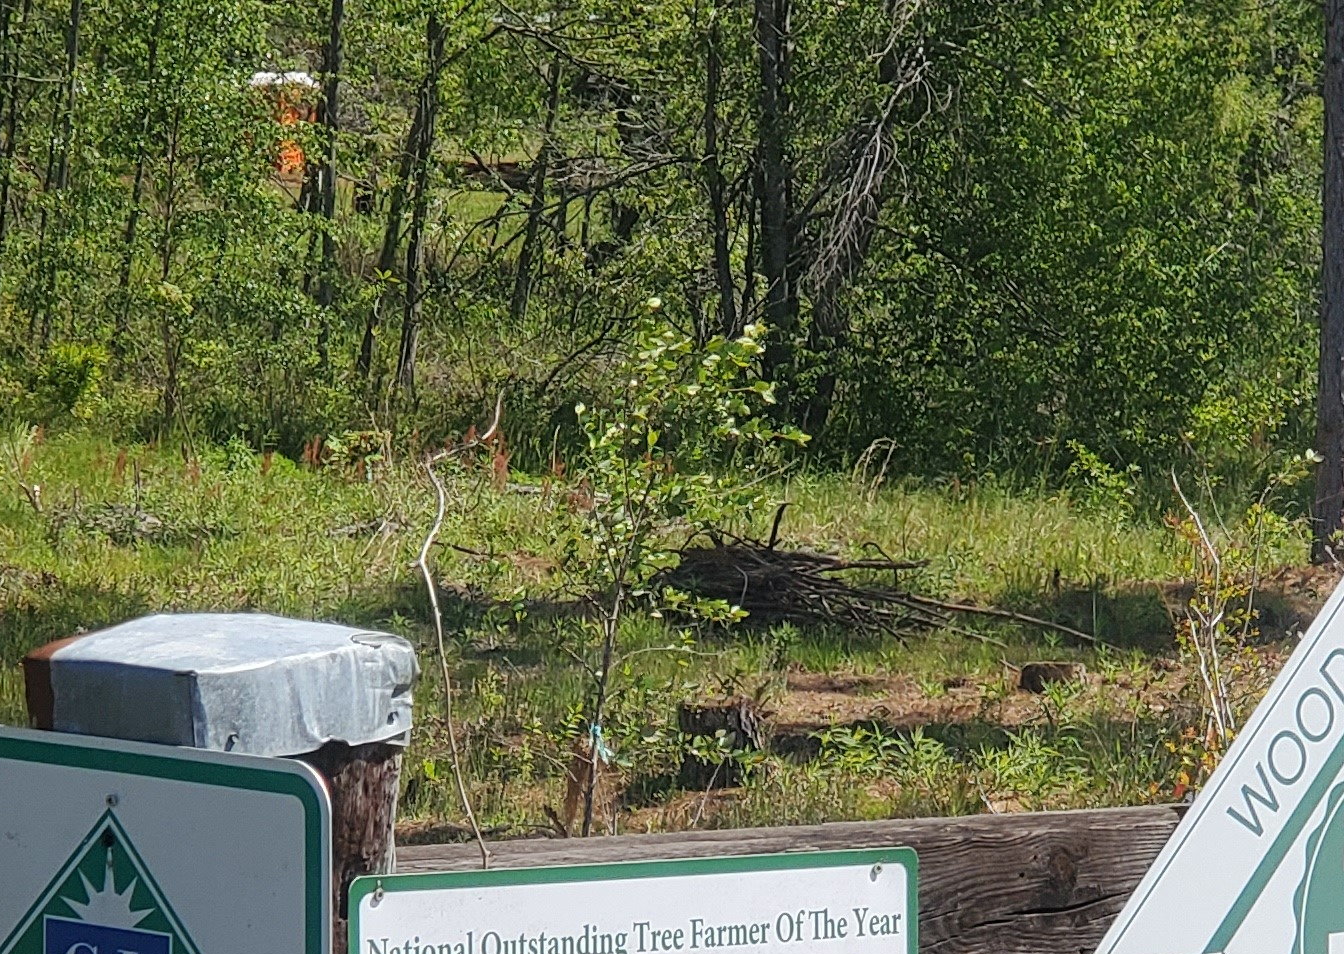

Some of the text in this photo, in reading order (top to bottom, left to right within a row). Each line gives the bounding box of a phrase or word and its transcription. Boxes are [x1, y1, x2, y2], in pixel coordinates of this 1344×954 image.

[633, 920, 685, 954] Tree
[689, 916, 771, 951] Farmer
[775, 909, 806, 943] Of
[808, 908, 848, 942] The
[852, 907, 902, 938] Year
